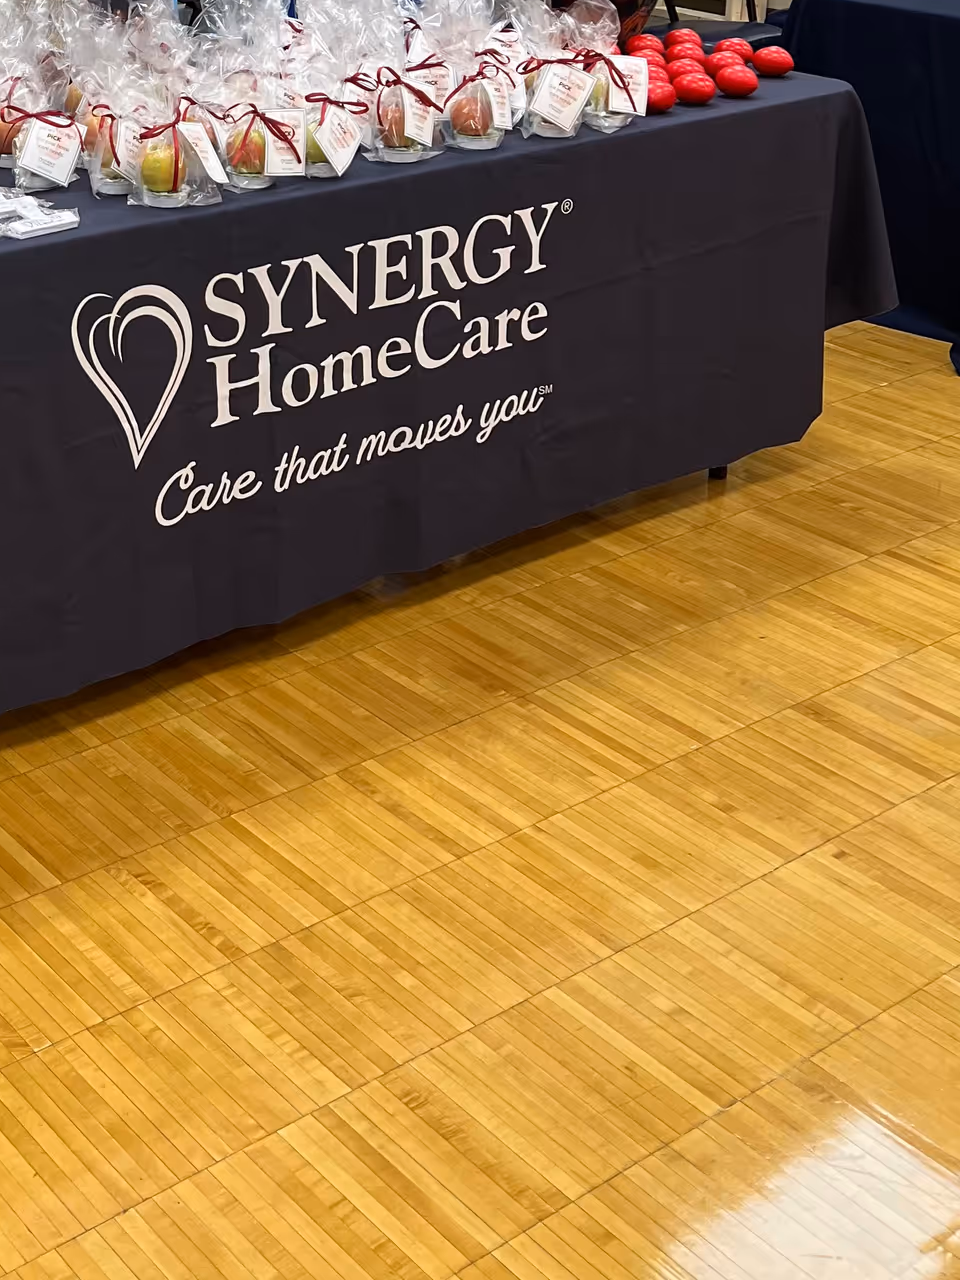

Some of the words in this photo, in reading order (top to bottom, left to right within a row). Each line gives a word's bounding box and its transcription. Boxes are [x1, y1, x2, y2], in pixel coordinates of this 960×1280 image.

[206, 299, 548, 428] HomeCare
[155, 462, 263, 527] Care
[274, 446, 350, 493] that
[355, 404, 472, 465] moves
